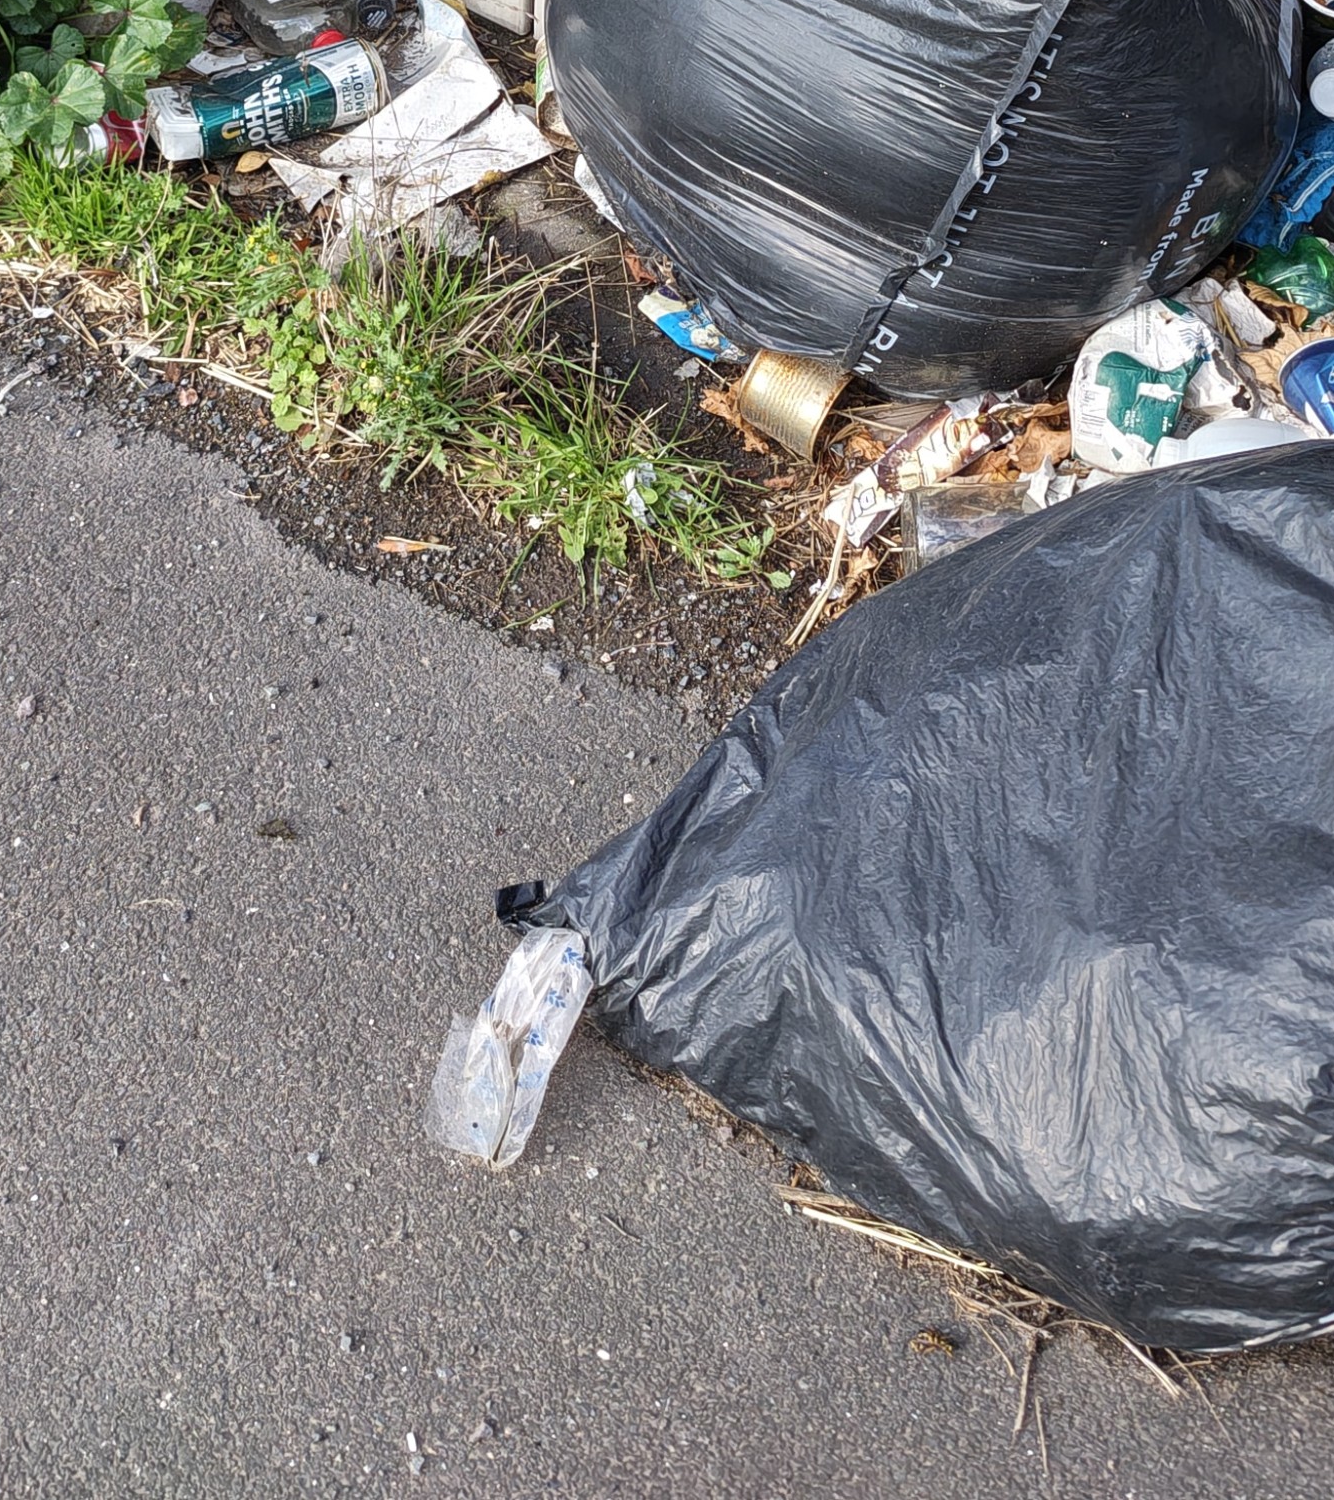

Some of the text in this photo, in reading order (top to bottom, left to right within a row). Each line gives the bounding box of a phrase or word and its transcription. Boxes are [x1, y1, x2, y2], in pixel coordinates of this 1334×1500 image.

[243, 92, 271, 147] JOHN
[340, 76, 354, 114] EXTRA
[347, 62, 367, 118] SMOOTH
[976, 105, 1028, 196] NOT
[1137, 166, 1210, 281] Made from
[1164, 211, 1219, 281] BIN
